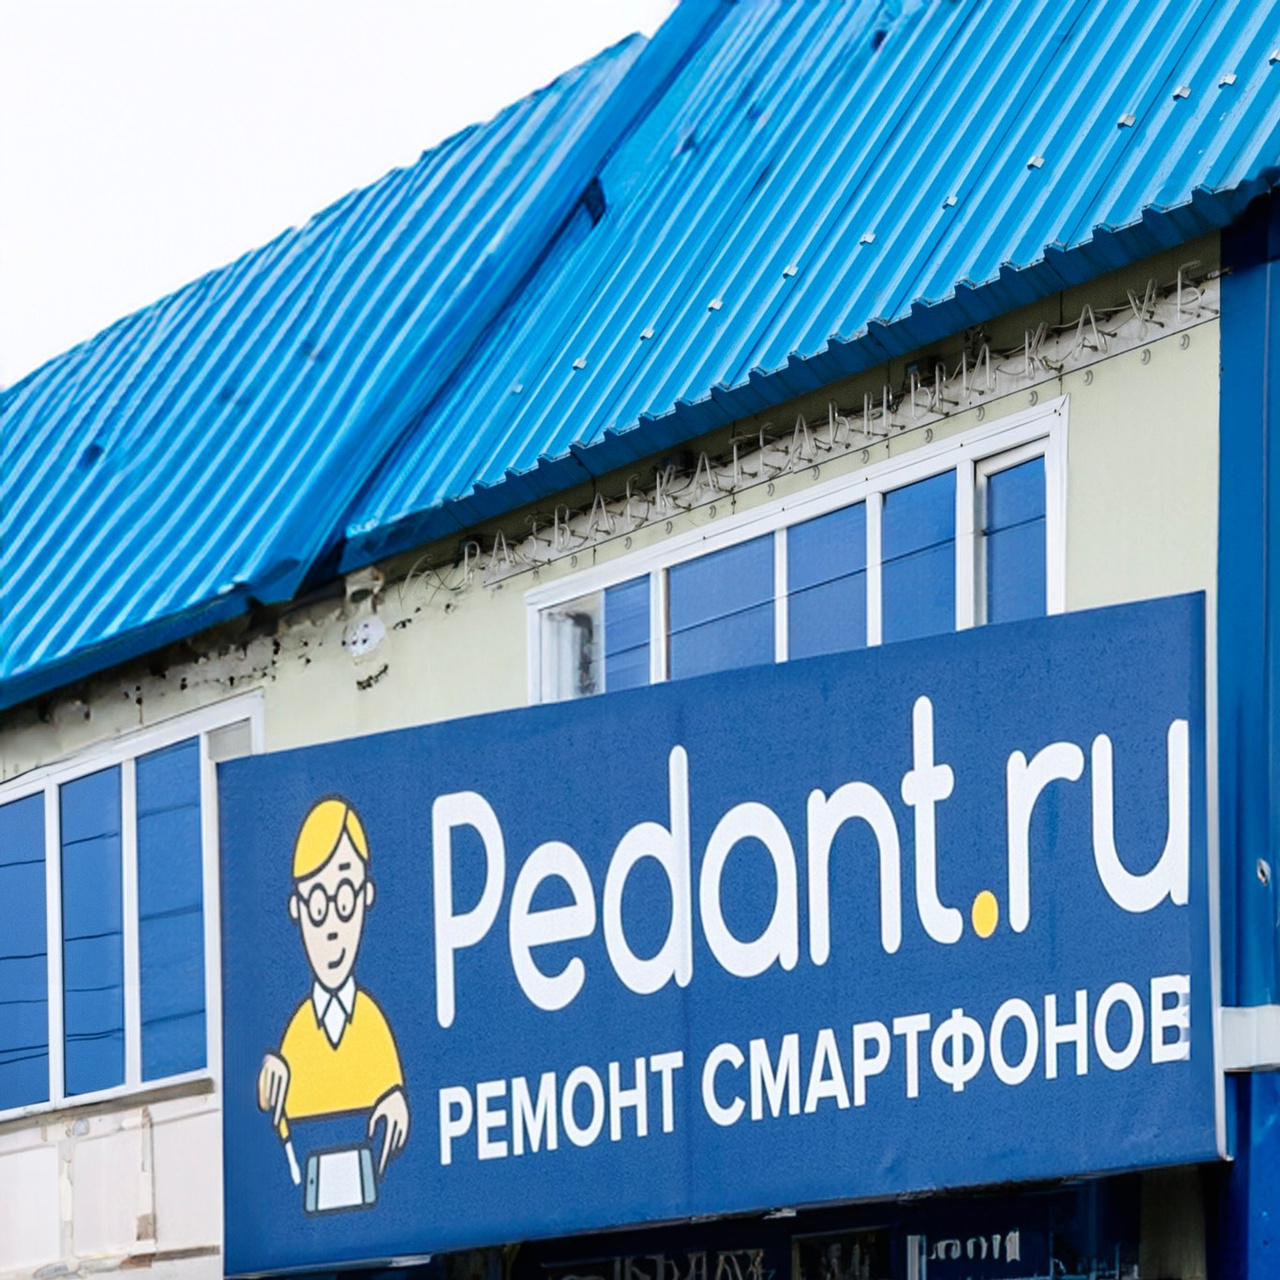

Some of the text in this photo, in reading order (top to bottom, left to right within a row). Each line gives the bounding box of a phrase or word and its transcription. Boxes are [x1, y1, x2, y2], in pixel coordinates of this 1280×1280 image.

[431, 694, 1191, 1030] Pedant.ru
[438, 973, 1191, 1166] РЕМОНТ СМАРТФОНОВ
